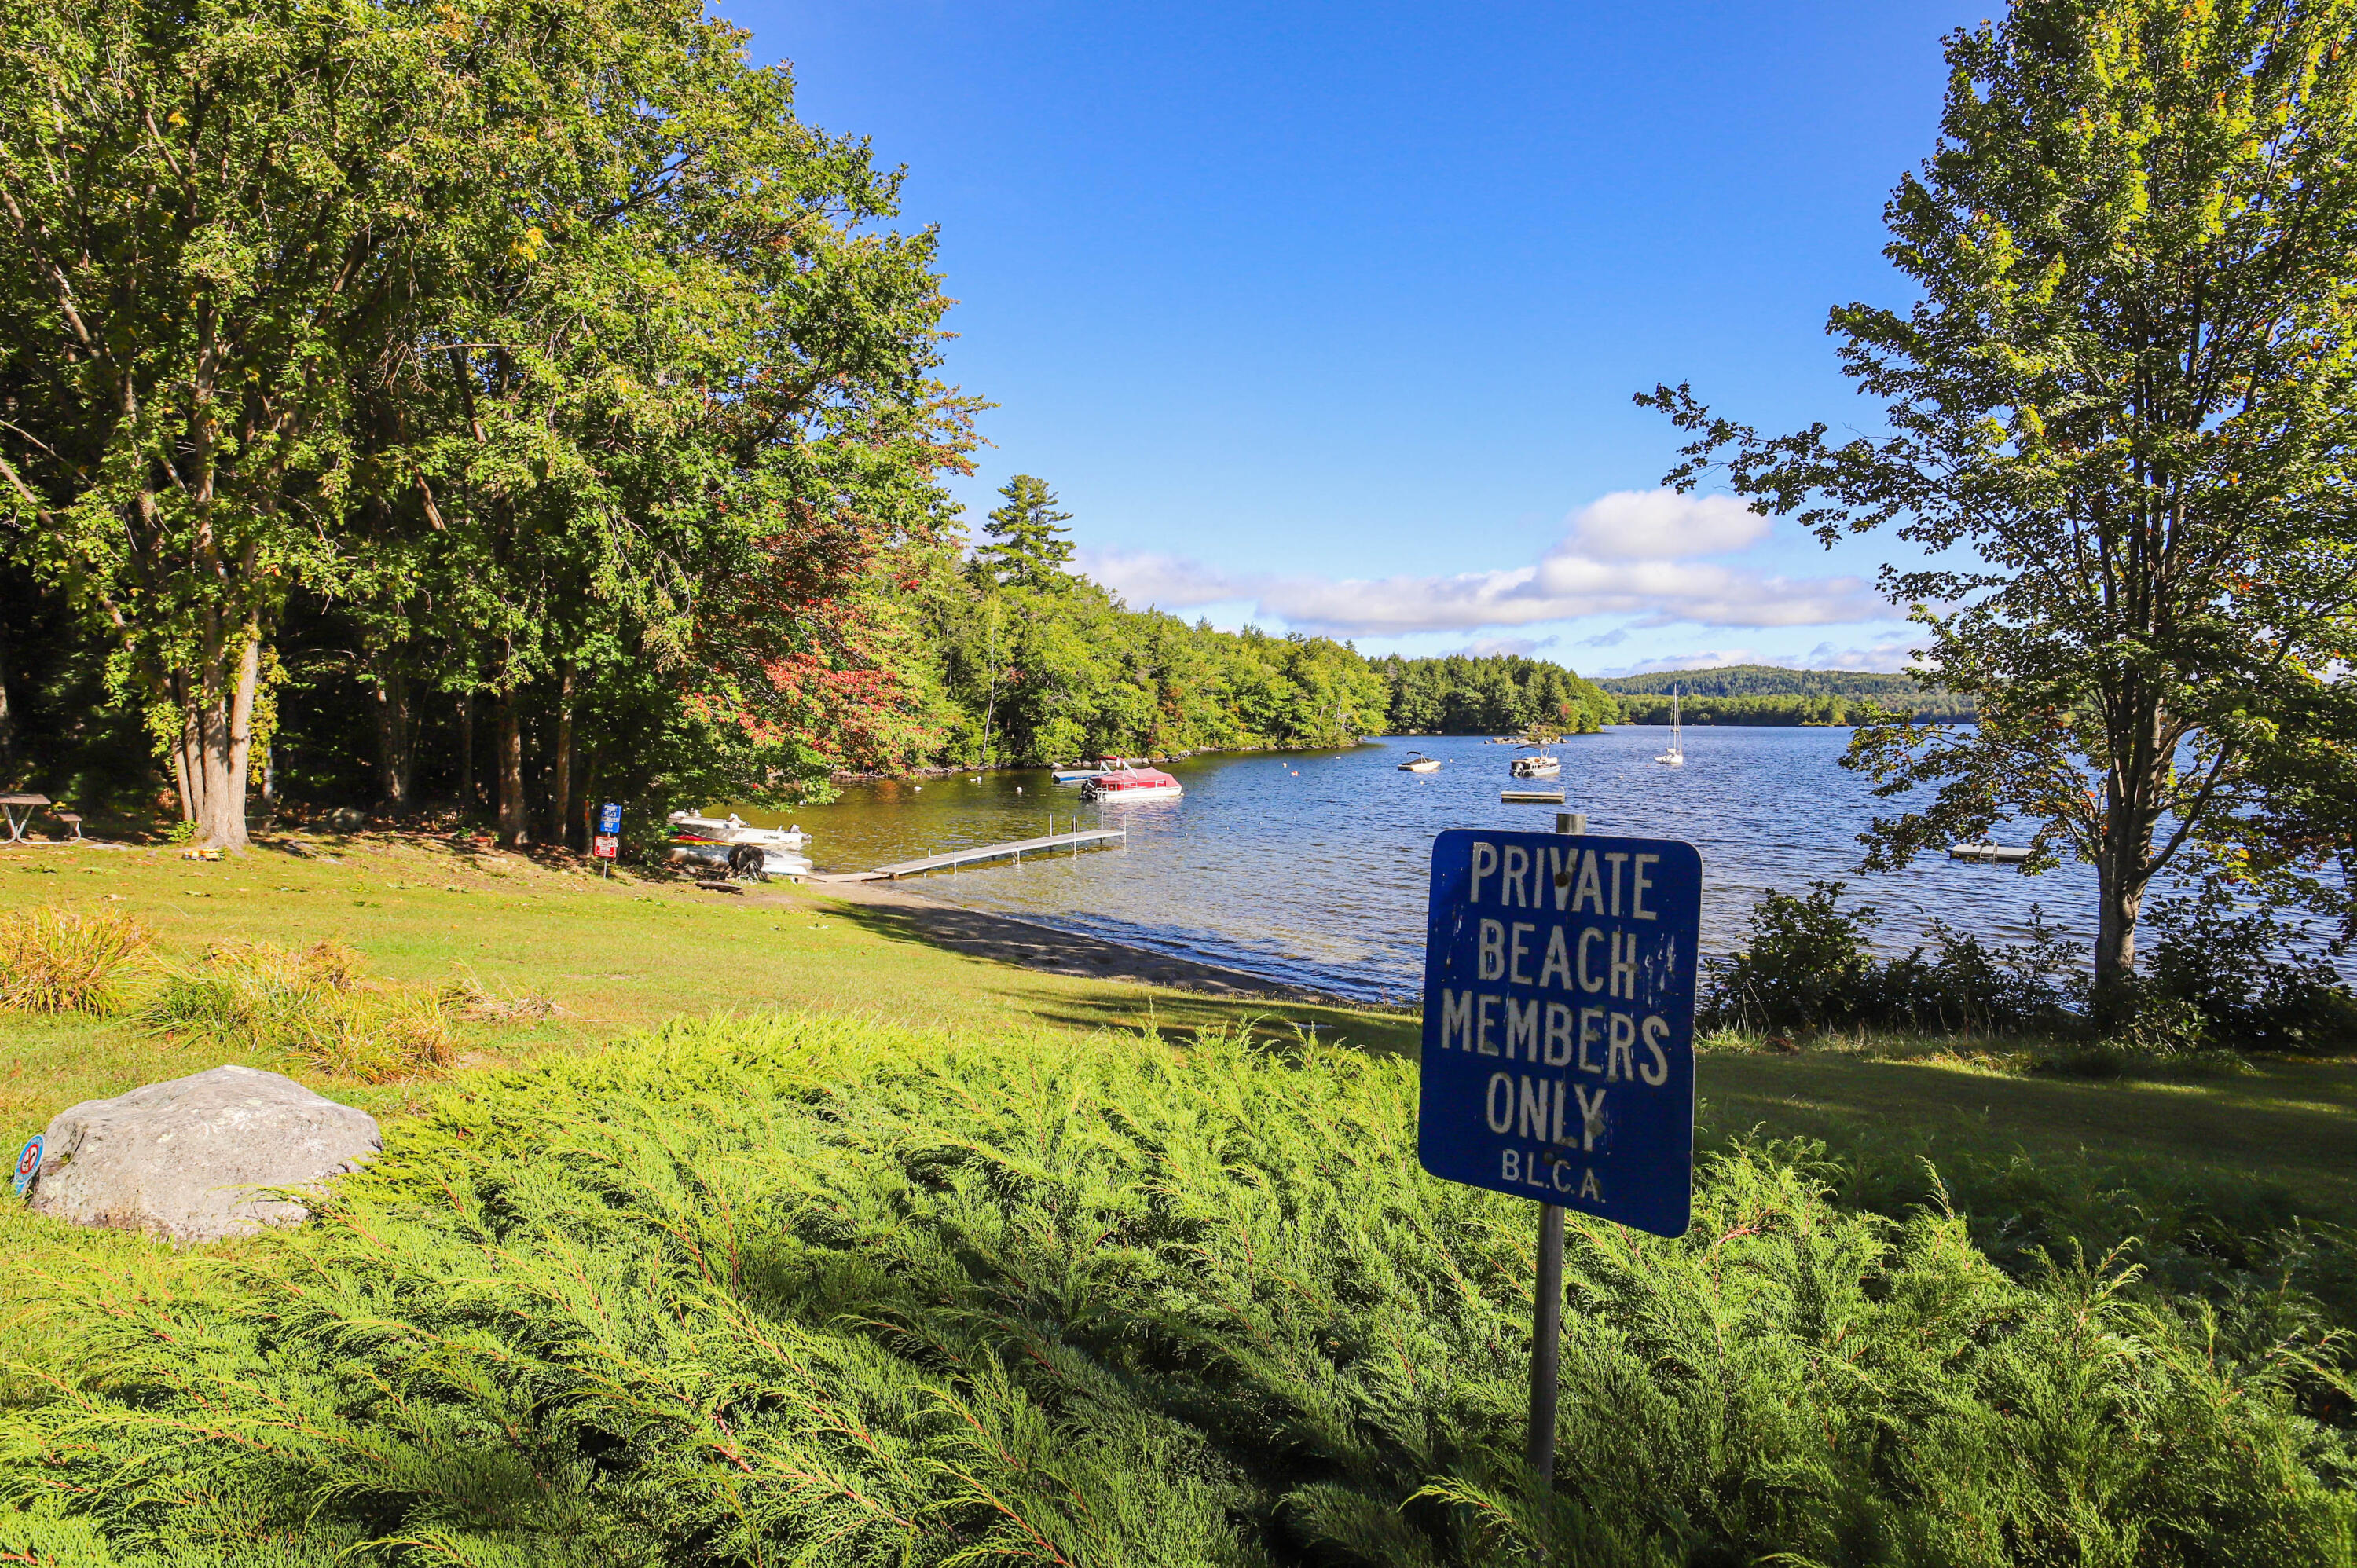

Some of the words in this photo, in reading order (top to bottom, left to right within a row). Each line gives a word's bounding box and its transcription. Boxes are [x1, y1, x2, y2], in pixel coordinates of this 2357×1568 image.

[1470, 841, 1659, 921] PRIVATE
[1477, 918, 1636, 1000] BEACH
[1441, 988, 1670, 1086] MEMBERS
[1486, 1072, 1607, 1152] ONLY
